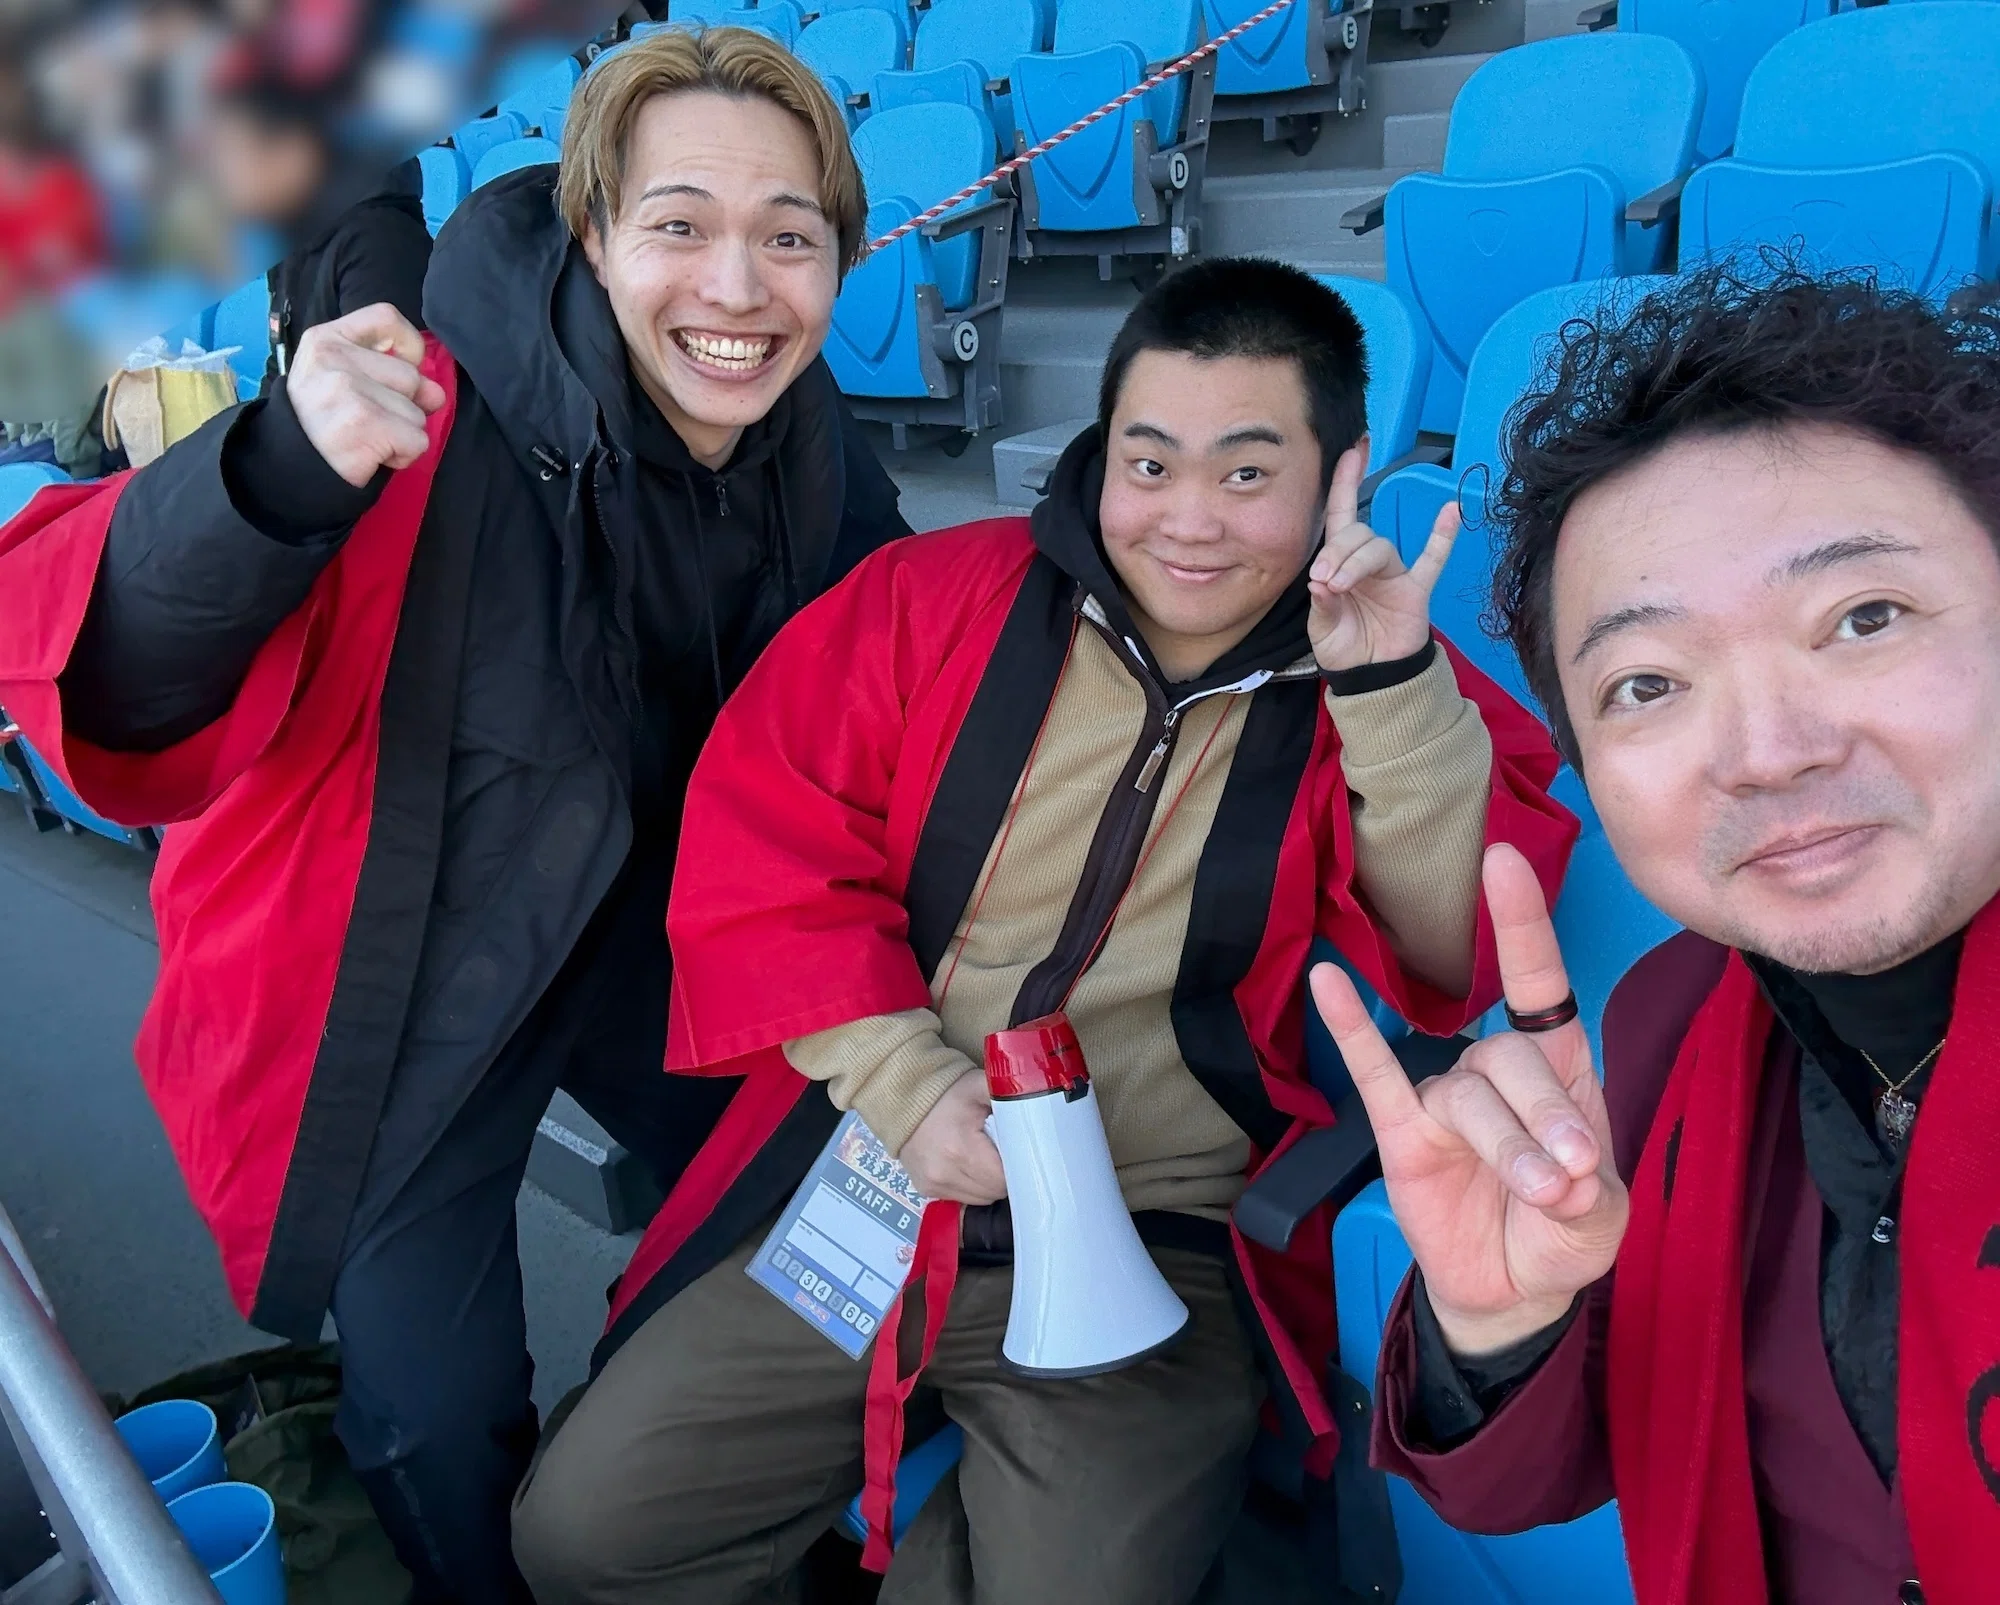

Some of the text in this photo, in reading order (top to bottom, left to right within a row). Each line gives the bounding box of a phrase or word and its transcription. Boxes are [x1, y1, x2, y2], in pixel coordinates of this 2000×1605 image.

[1346, 22, 1354, 43] E
[1175, 159, 1185, 182] D
[960, 328, 974, 354] C
[845, 1176, 893, 1214] STAFF
[896, 1212, 911, 1230] B
